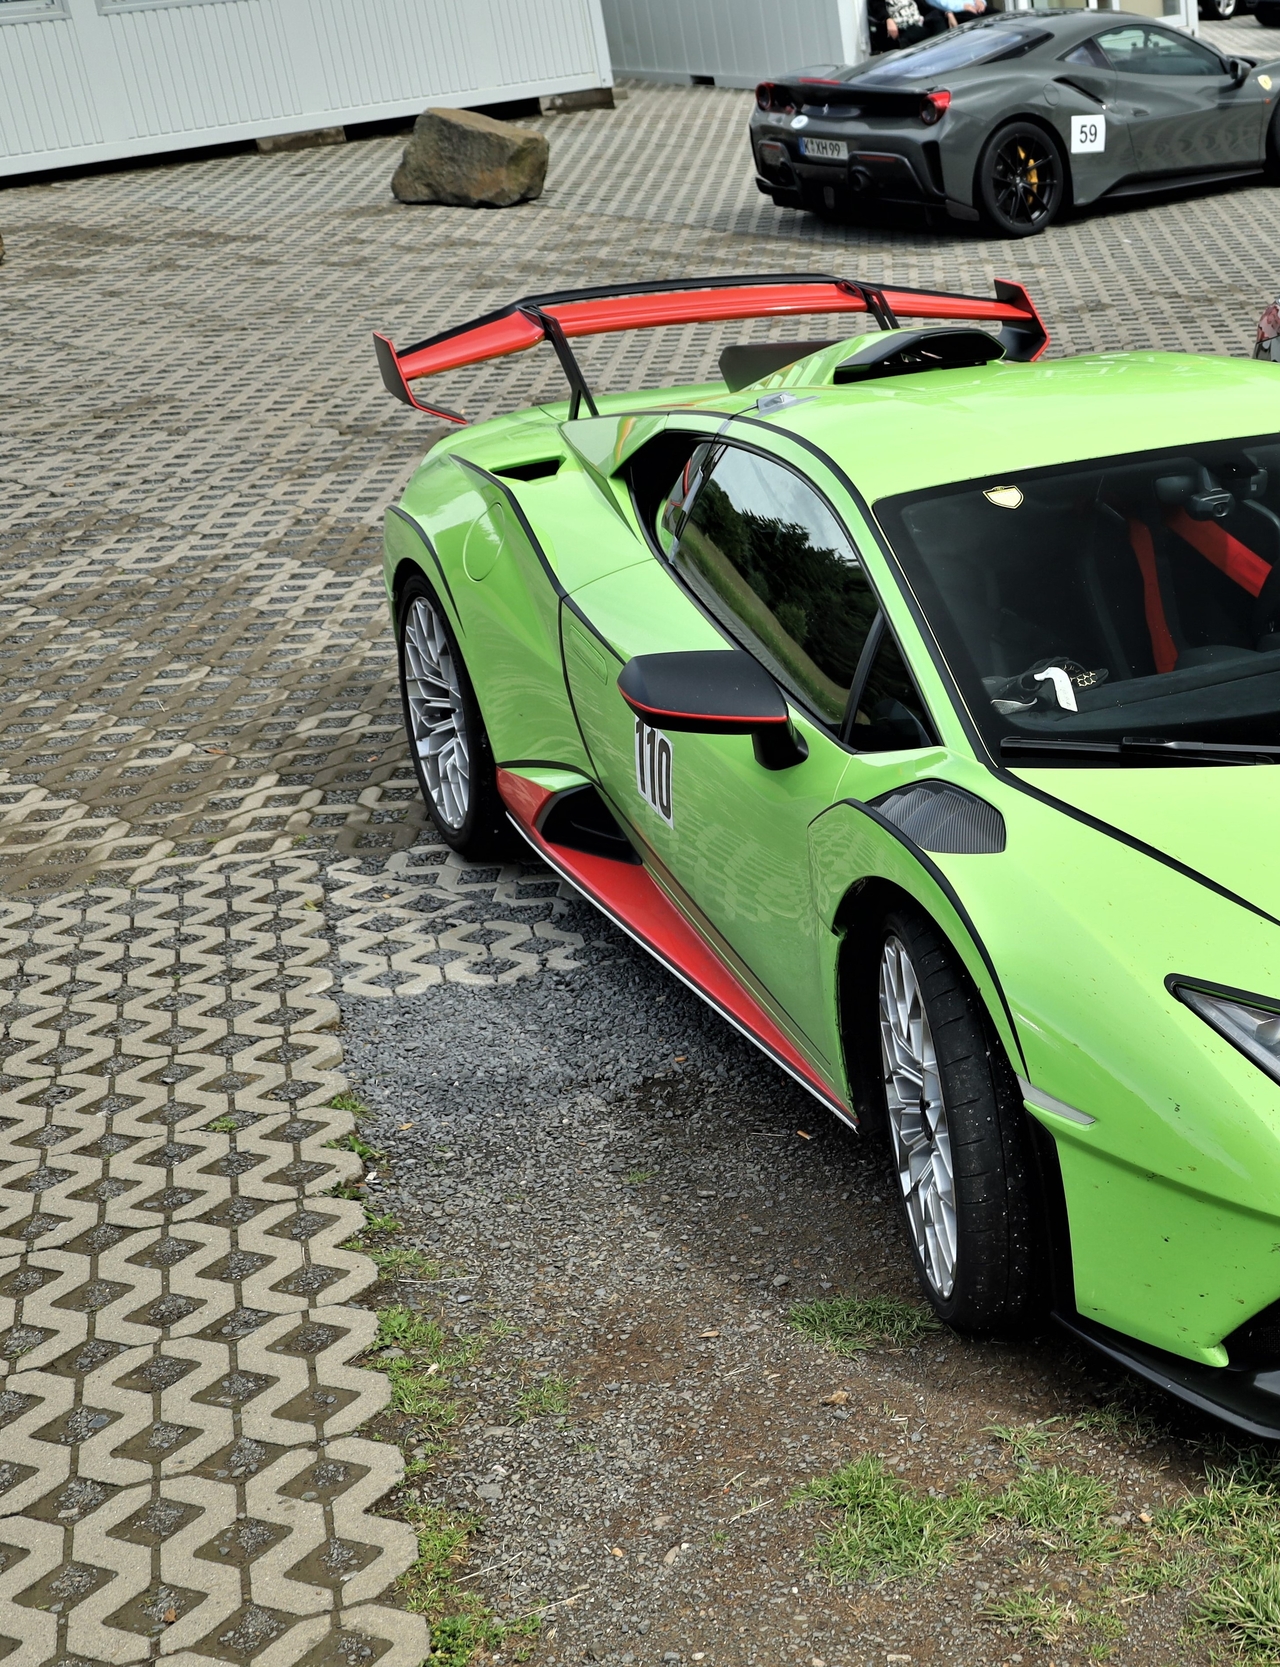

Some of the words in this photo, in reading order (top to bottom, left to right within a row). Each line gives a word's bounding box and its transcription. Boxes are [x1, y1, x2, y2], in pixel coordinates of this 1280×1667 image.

[1079, 123, 1098, 144] 59
[803, 139, 811, 153] K
[815, 140, 828, 156] XH
[829, 142, 841, 157] 99
[635, 719, 671, 820] 110
